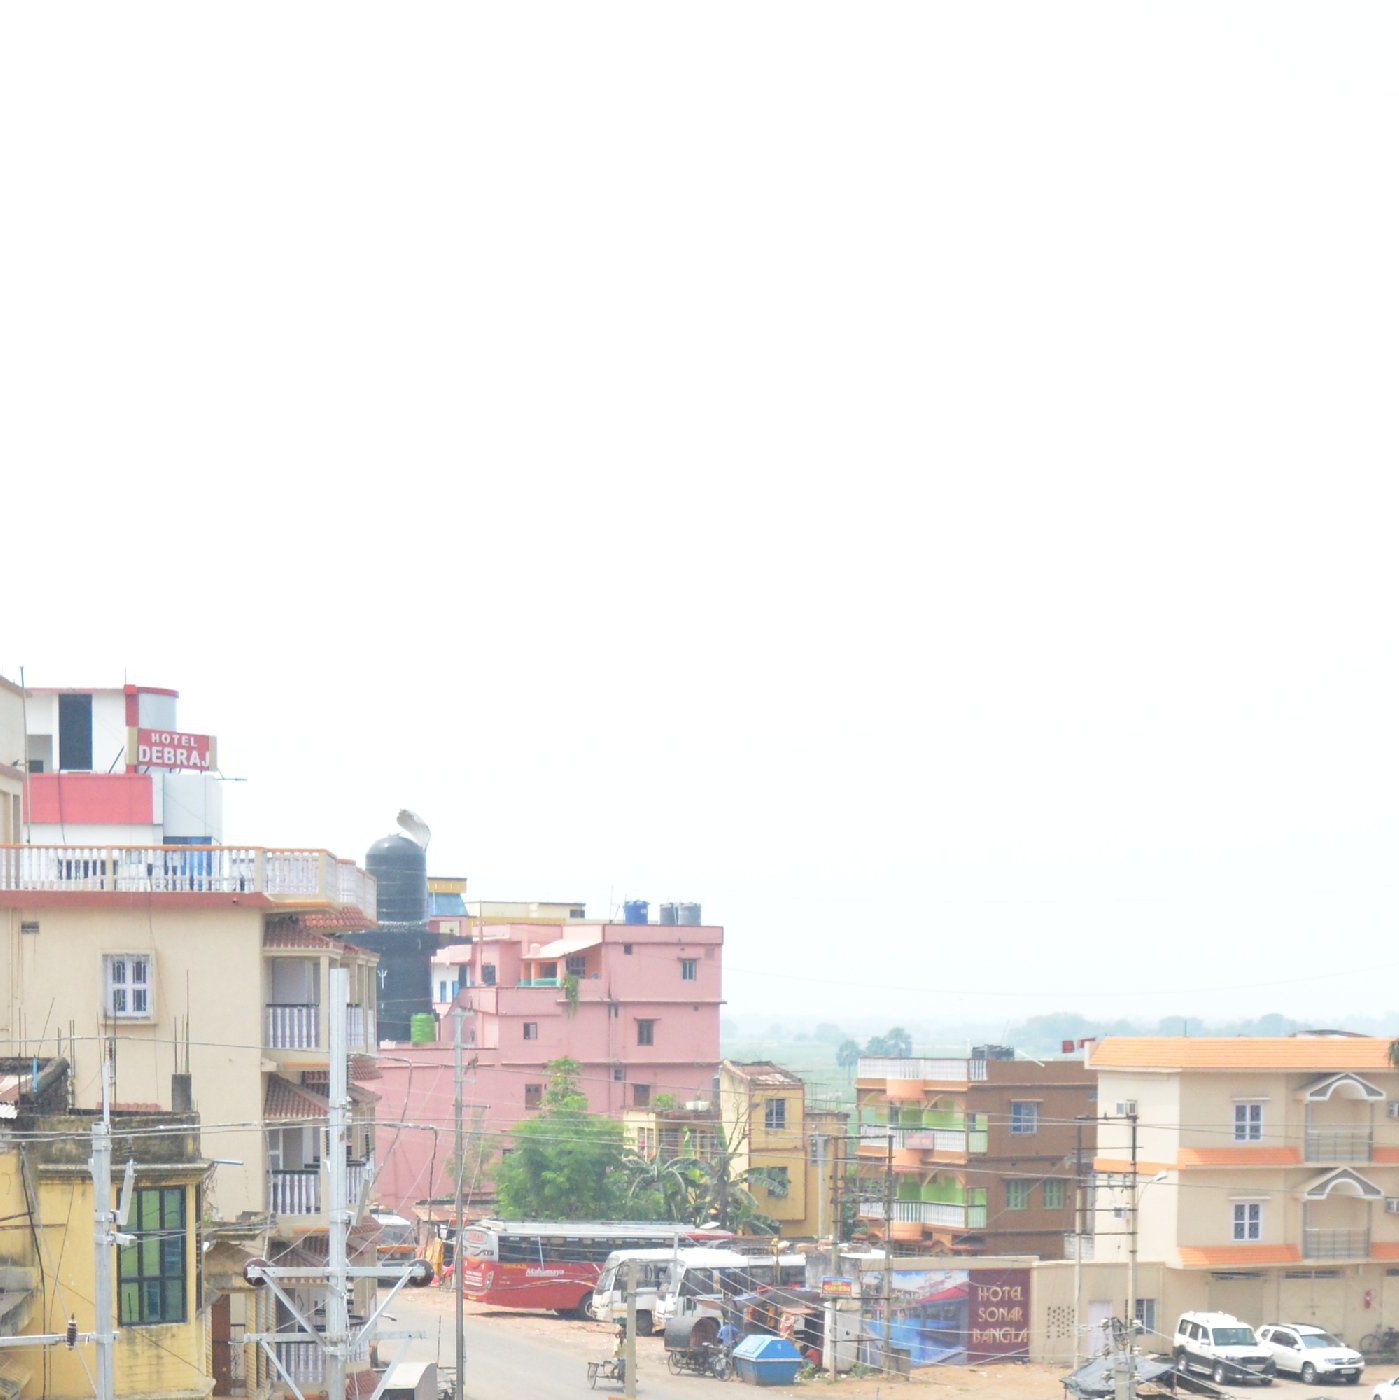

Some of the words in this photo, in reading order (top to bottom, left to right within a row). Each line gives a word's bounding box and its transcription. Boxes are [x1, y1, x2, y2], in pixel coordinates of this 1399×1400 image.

[151, 732, 198, 747] HOTEL
[138, 745, 209, 767] DEBRAJ
[978, 1285, 1024, 1301] HOTEL
[978, 1306, 1024, 1321] SONAR
[972, 1327, 1030, 1344] BANGLA
